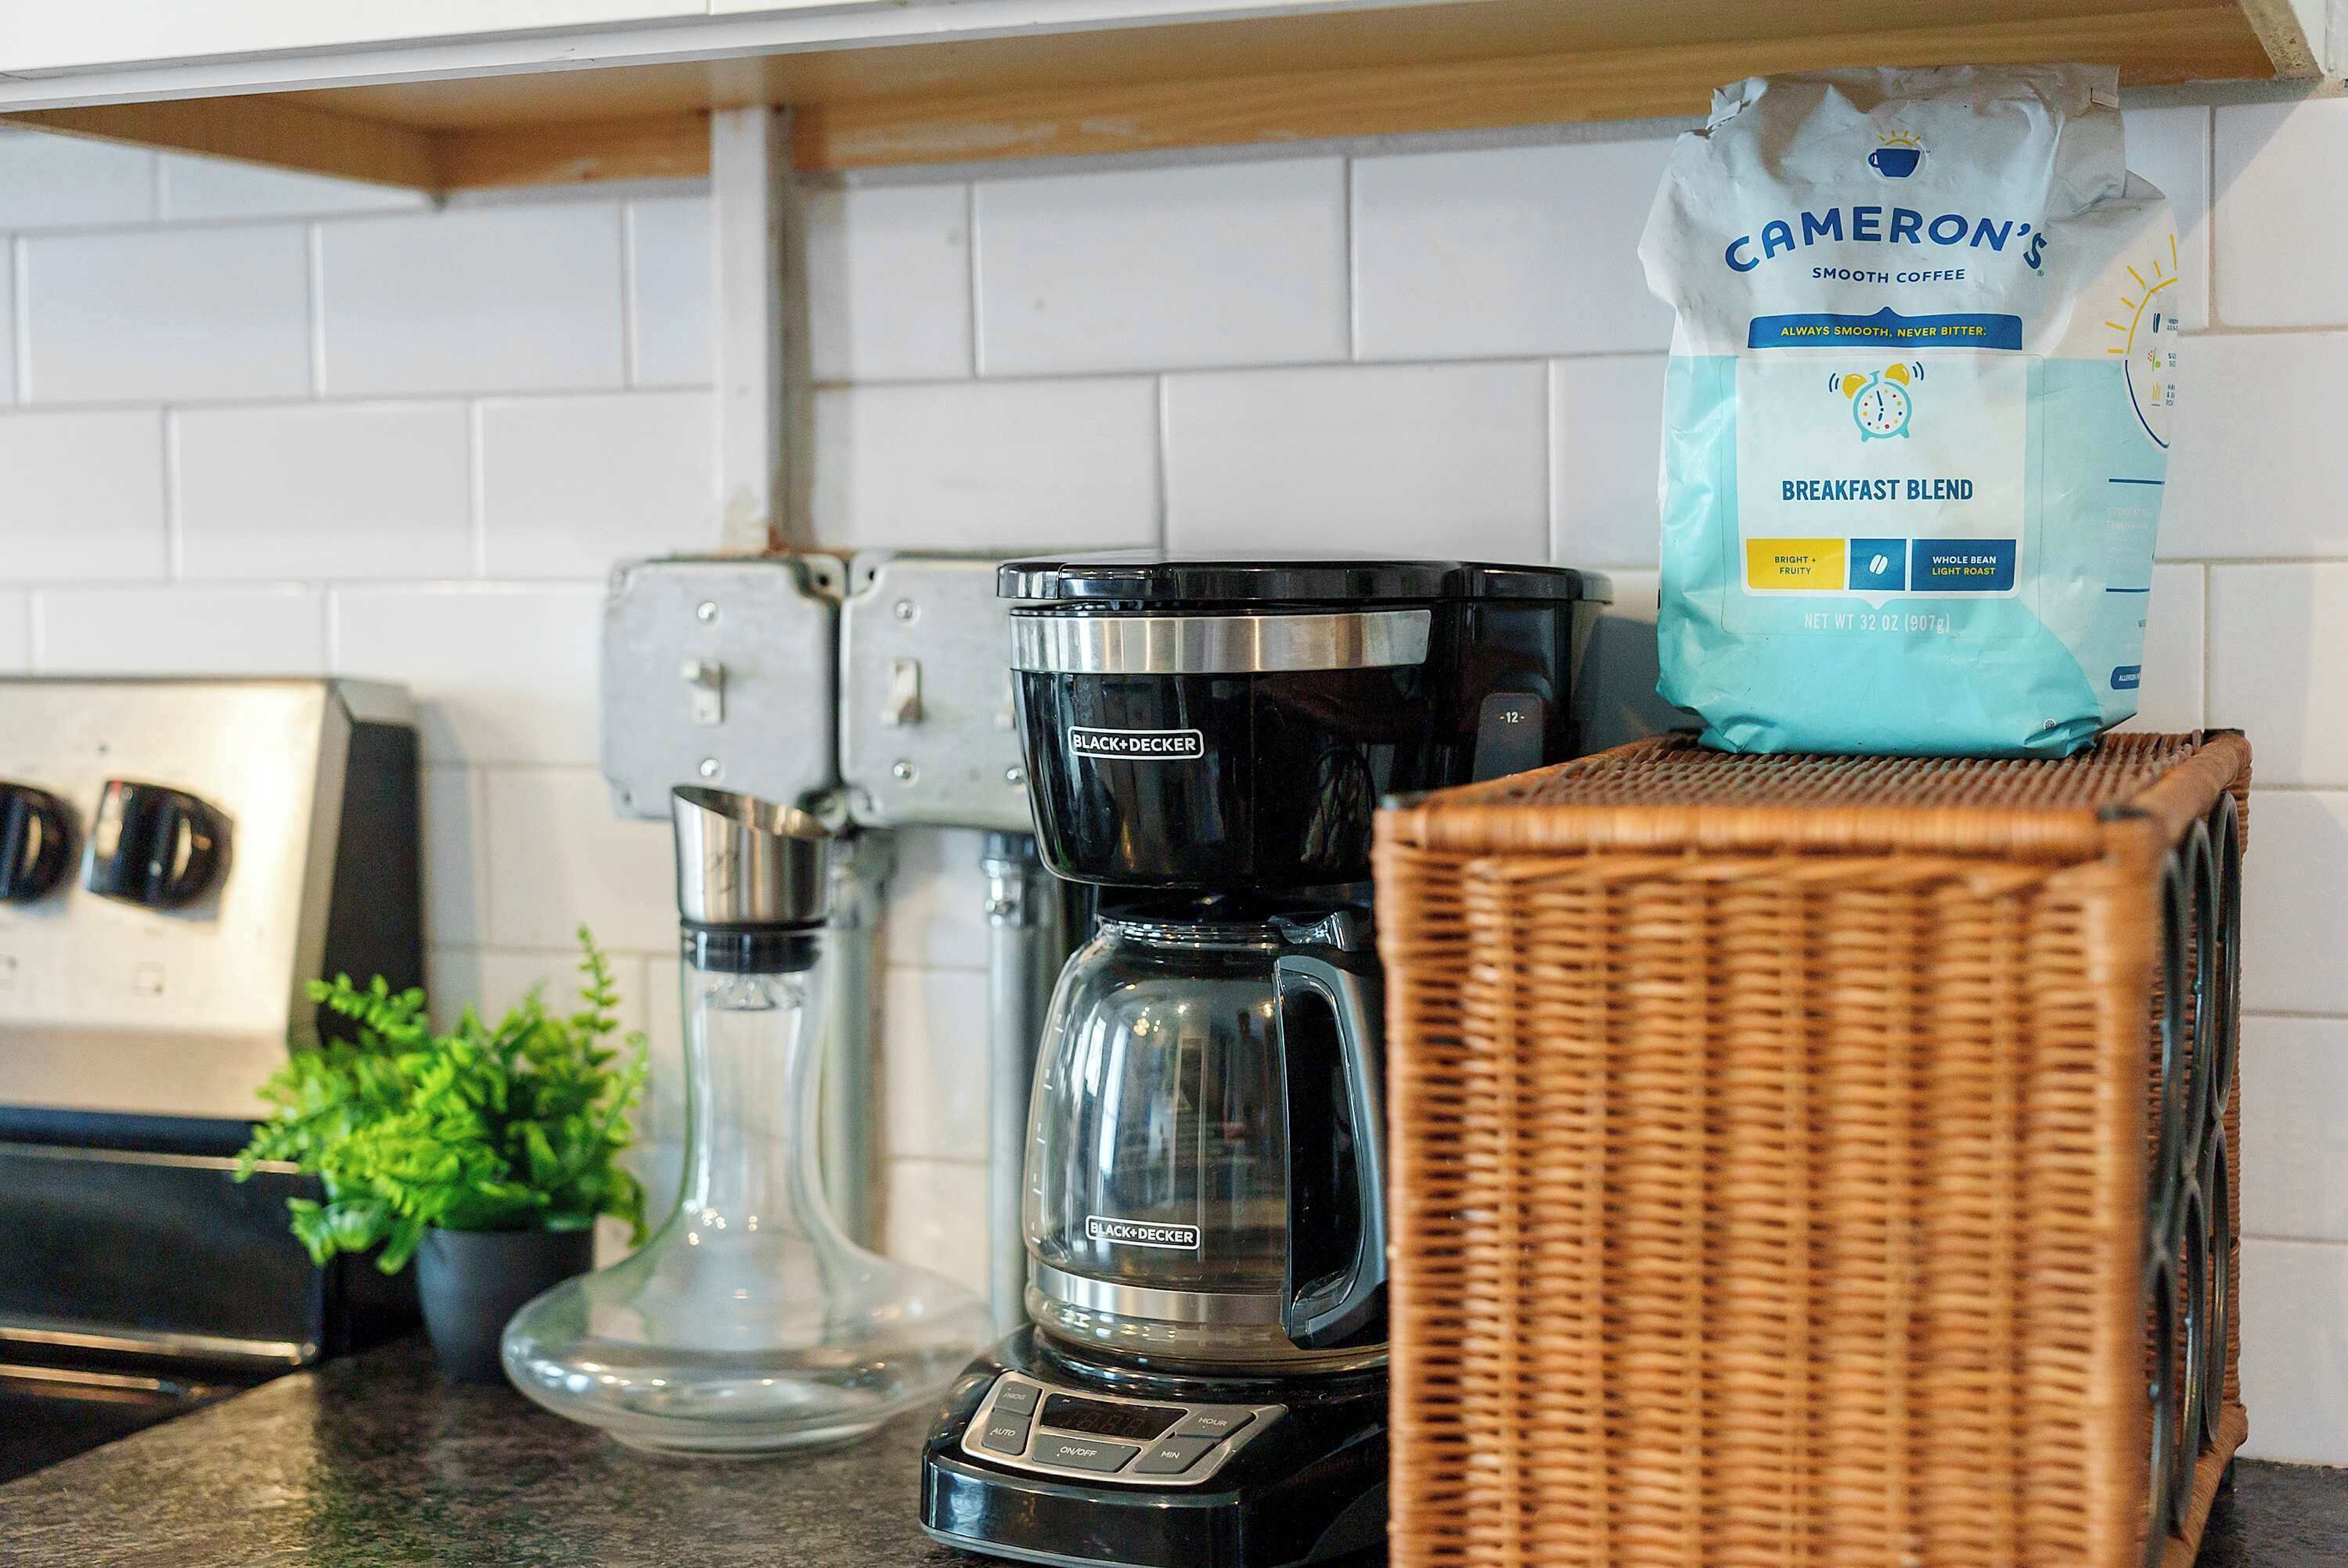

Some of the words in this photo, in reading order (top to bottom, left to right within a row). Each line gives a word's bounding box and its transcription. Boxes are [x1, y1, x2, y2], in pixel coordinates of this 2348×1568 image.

[1724, 206, 2047, 270] CAMERON'S
[1812, 267, 1889, 283] SMOOTH
[1896, 268, 1965, 283] COFFEE
[1781, 325, 1830, 336] ALWAYS
[1834, 326, 1892, 338] SMOOTH,
[1897, 327, 1936, 337] NEVER
[1782, 480, 1900, 501] BREAKFAST
[1907, 479, 1973, 500] BLEND
[1774, 556, 1808, 564] BRIGHT
[1932, 556, 1968, 565] WHOLE
[1971, 556, 1997, 564] BEAN
[1932, 567, 1961, 576] LIGHT
[1805, 613, 1829, 629] NET
[1835, 613, 1854, 629] WT
[1860, 614, 1876, 630] 32
[1882, 614, 1899, 631] OZ
[1904, 613, 1950, 634] (907g)
[1073, 734, 1196, 752] BLACK+DECKER
[1089, 1221, 1194, 1243] BLACK+DECKER
[1197, 1416, 1227, 1427] HOUR
[991, 1427, 1016, 1437] AUTO
[1060, 1445, 1097, 1457] ON/OFF
[1160, 1450, 1180, 1459] MIN
